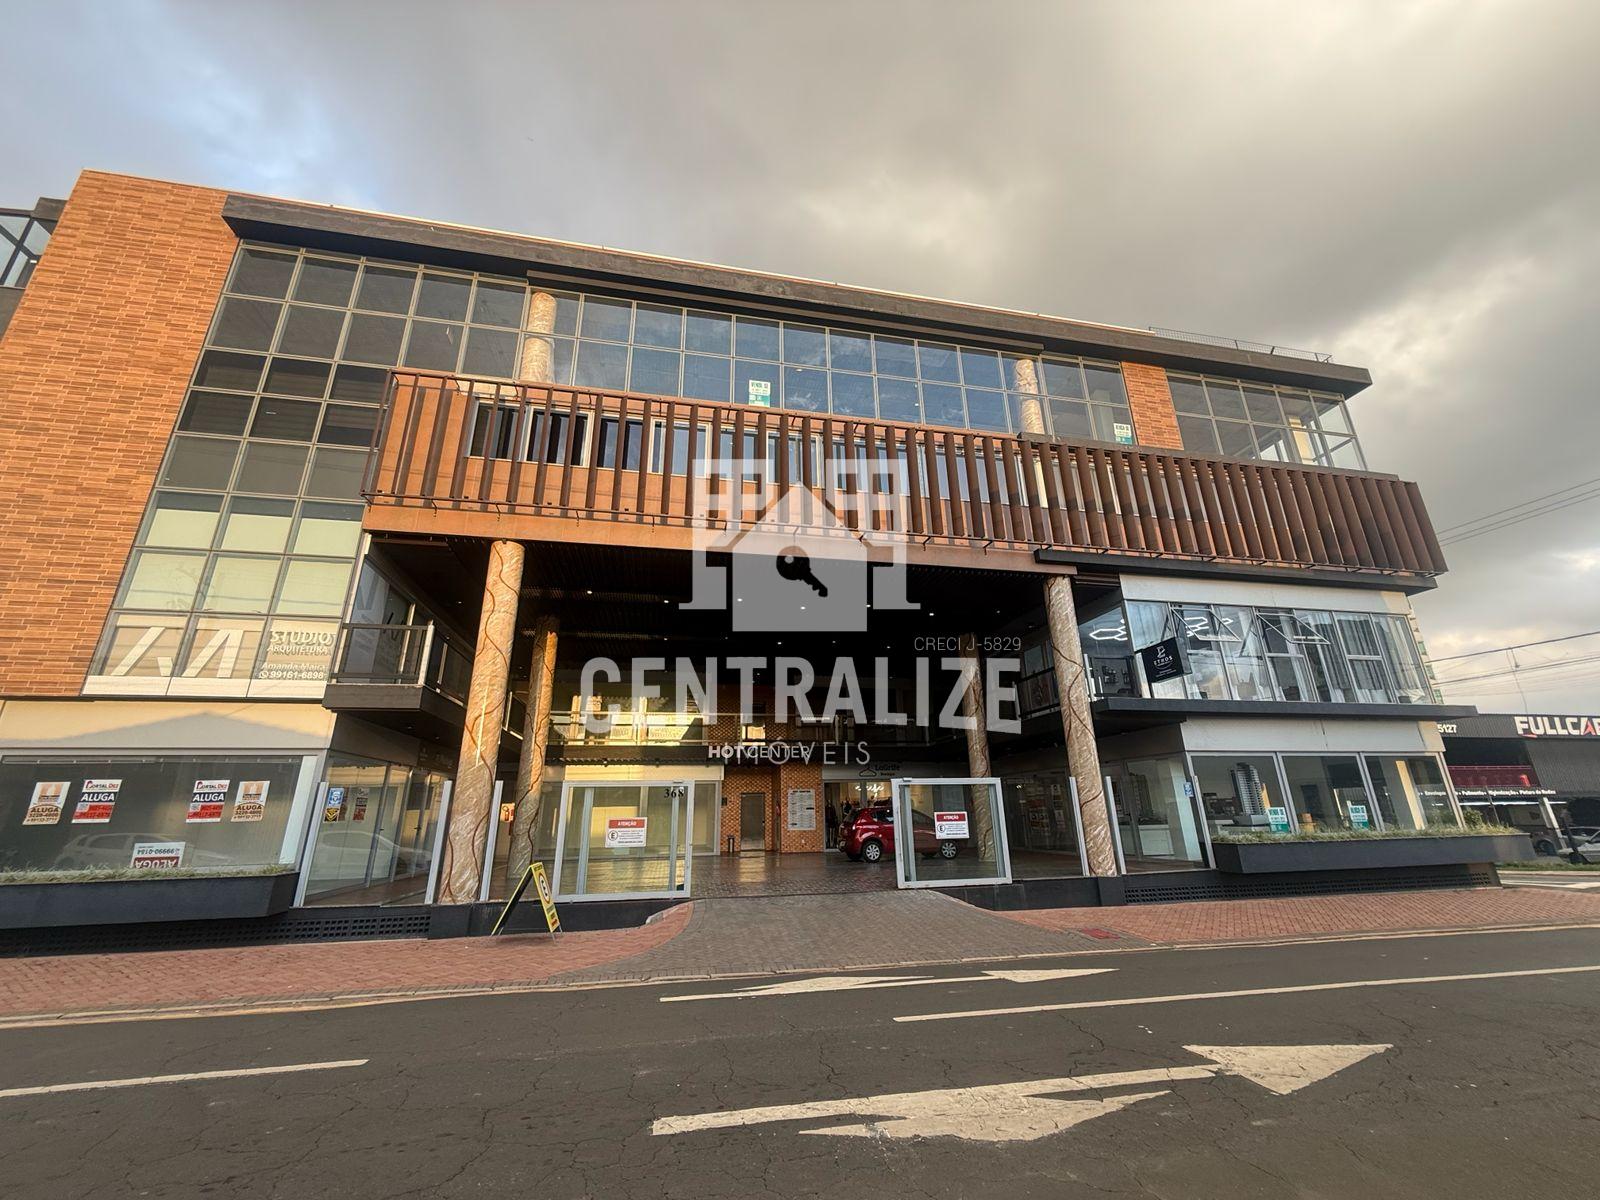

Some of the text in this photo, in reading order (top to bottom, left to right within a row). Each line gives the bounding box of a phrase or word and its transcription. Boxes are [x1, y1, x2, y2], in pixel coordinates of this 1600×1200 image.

[270, 631, 332, 644] STUDIO
[267, 644, 329, 654] ARQUITETURA
[269, 670, 324, 679] 99161-6898
[1437, 723, 1457, 733] 5127
[80, 793, 115, 802] ALUGA
[192, 793, 225, 802] ALUGA
[663, 788, 685, 799] 368
[135, 859, 177, 869] ALUGA
